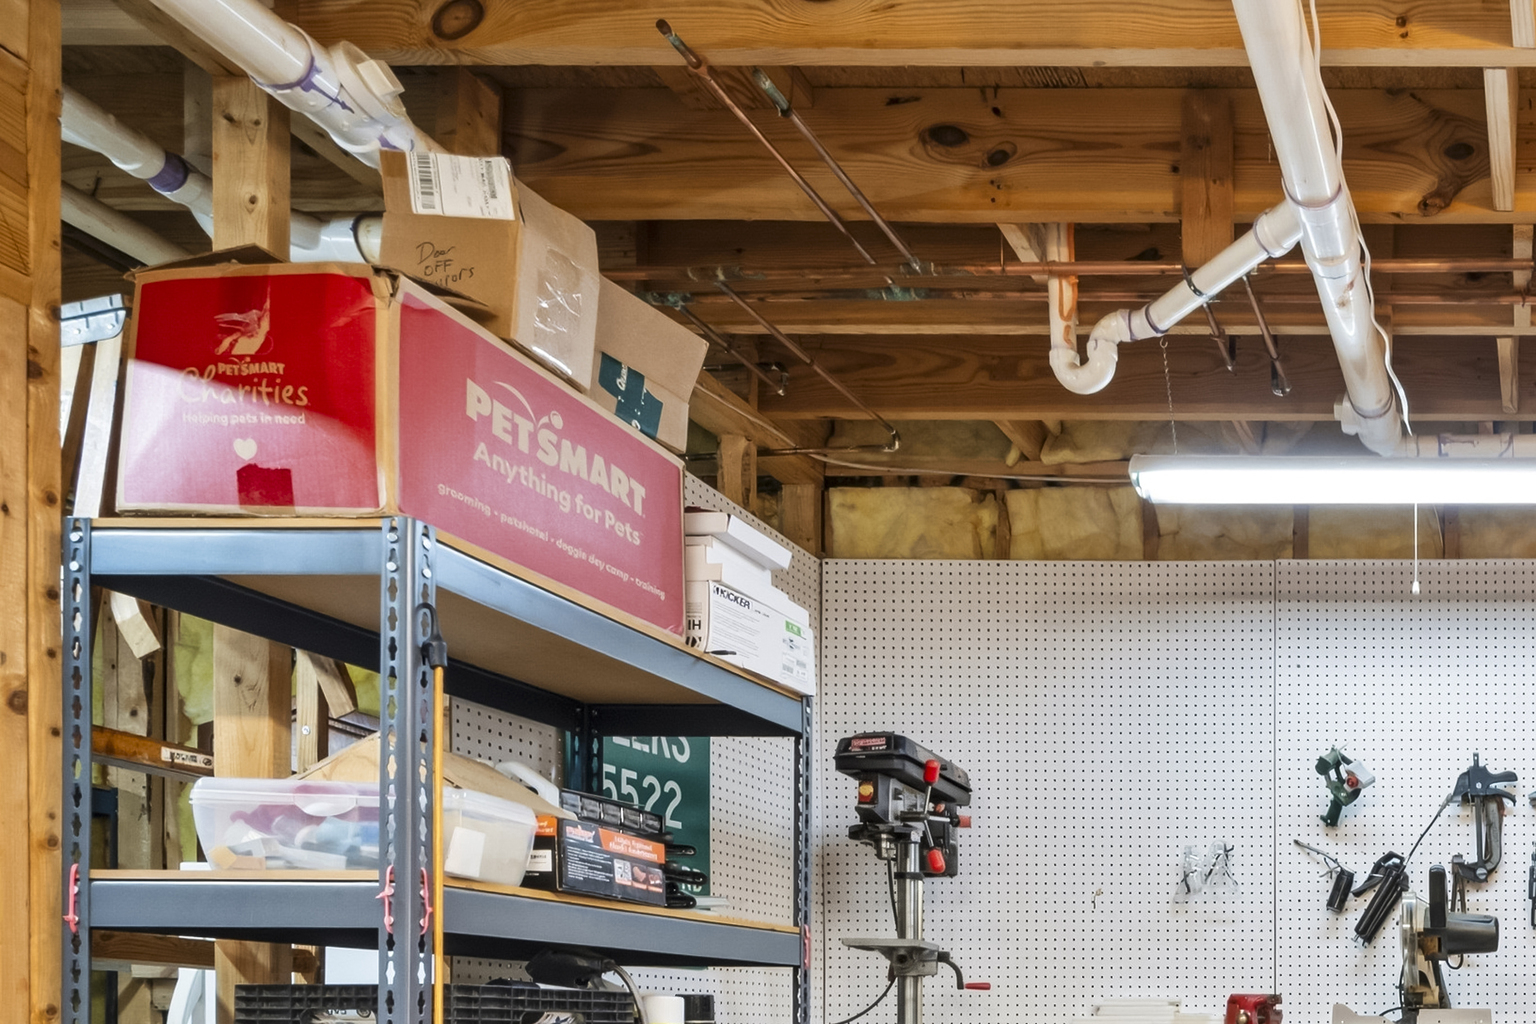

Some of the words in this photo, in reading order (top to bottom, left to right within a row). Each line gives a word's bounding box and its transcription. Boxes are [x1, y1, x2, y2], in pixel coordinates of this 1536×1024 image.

[180, 364, 309, 406] Charities
[217, 356, 285, 376] PETSMART
[183, 412, 228, 427] Helping
[230, 413, 258, 425] pets
[260, 412, 273, 424] in
[275, 412, 305, 424] need
[466, 378, 646, 518] PETSMART
[473, 441, 572, 514] Anything
[574, 494, 603, 524] for
[604, 510, 641, 546] Pets
[437, 483, 492, 517] grooming
[556, 538, 587, 561] doggie
[588, 552, 605, 573] day
[606, 564, 630, 583] camp
[635, 577, 666, 601] training
[720, 588, 751, 610] KICKER
